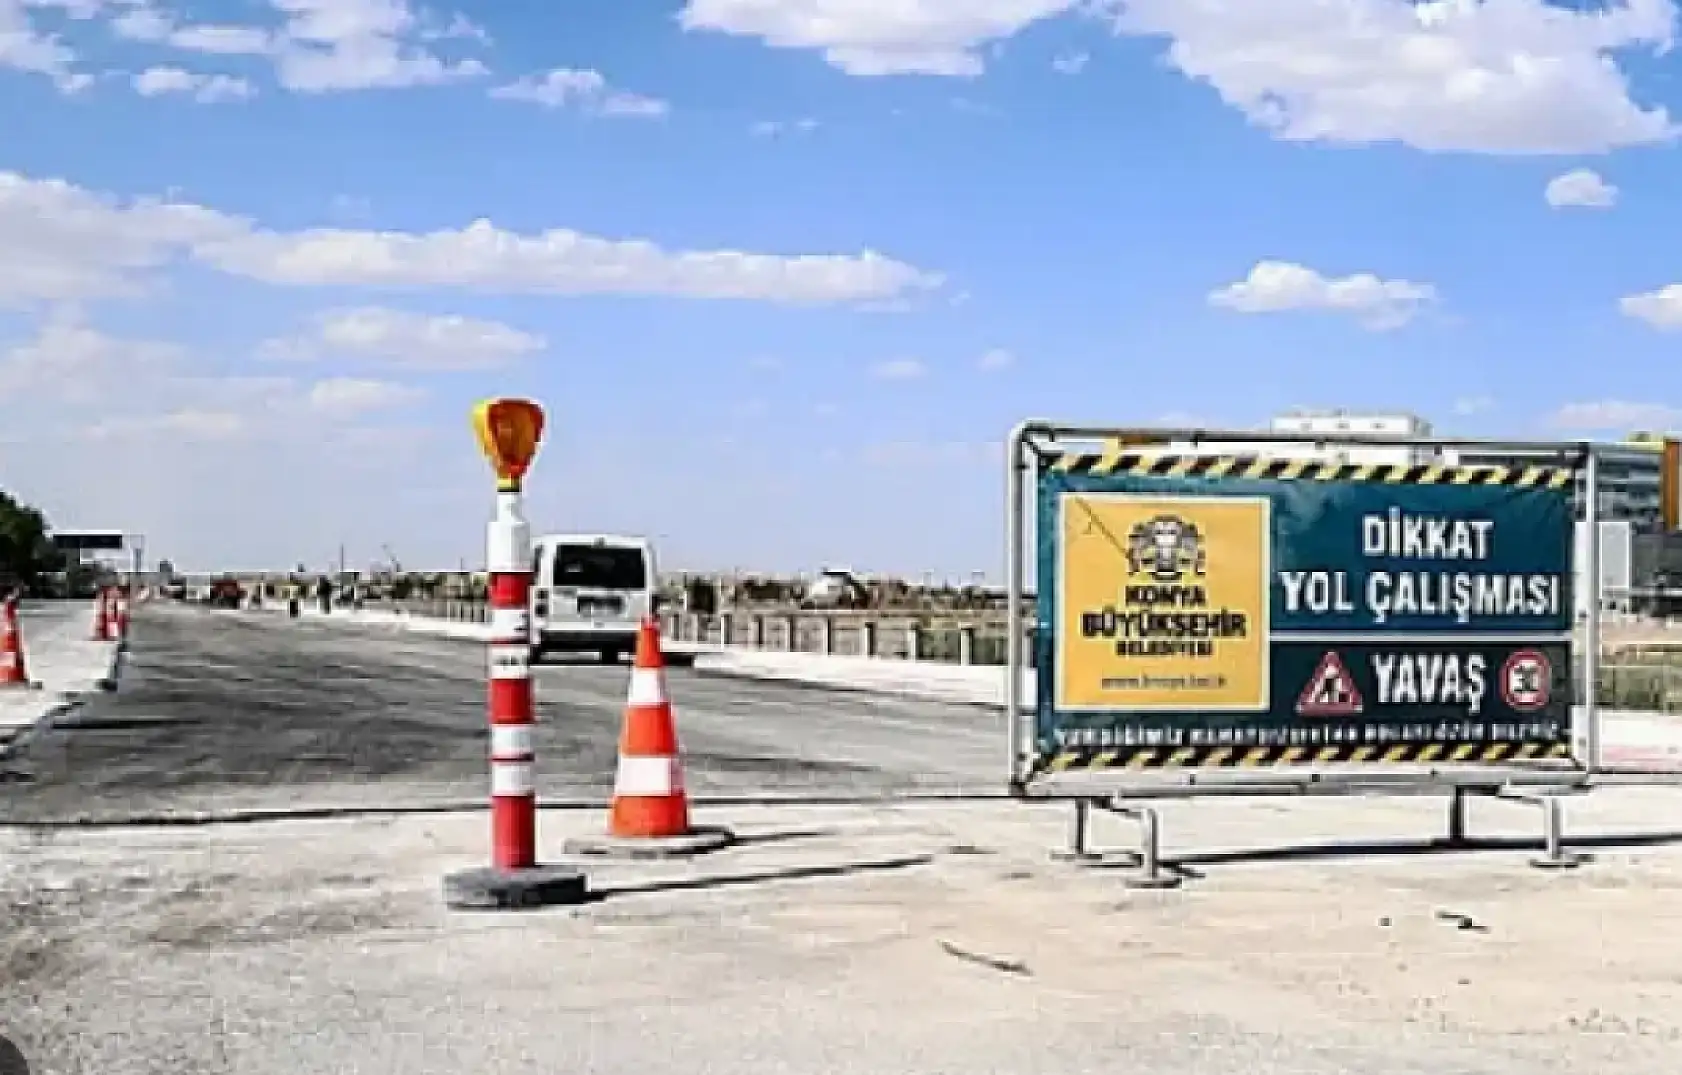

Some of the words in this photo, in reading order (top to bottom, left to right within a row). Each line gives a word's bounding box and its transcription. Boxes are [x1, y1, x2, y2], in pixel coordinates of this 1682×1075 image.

[1362, 506, 1494, 560] DİKKAT
[1279, 571, 1354, 612] YOL
[1372, 653, 1488, 714] YAVAŞ
